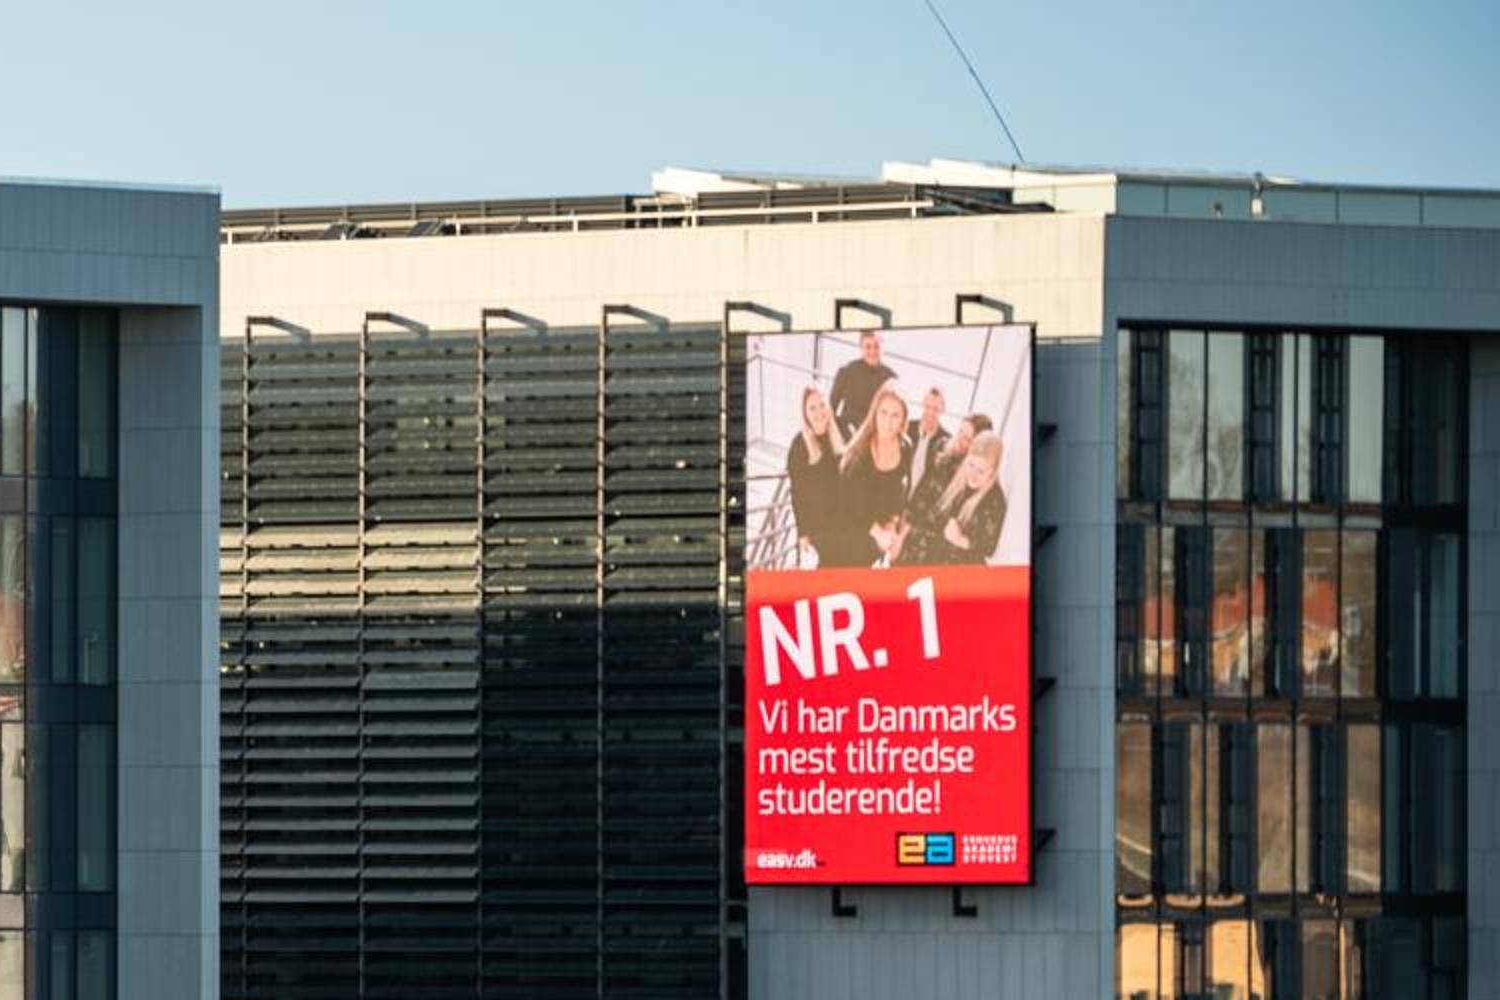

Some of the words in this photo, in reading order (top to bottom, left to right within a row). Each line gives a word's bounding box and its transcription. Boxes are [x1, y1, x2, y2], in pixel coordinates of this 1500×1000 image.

[759, 591, 889, 686] NR.
[906, 576, 941, 659] 1
[758, 699, 788, 734] Vi
[797, 697, 849, 733] har
[858, 695, 1017, 733] Danmarks
[758, 742, 837, 774] mest
[845, 737, 975, 774] tilfredse
[758, 778, 941, 815] studerende!
[757, 849, 816, 869] easv.dk
